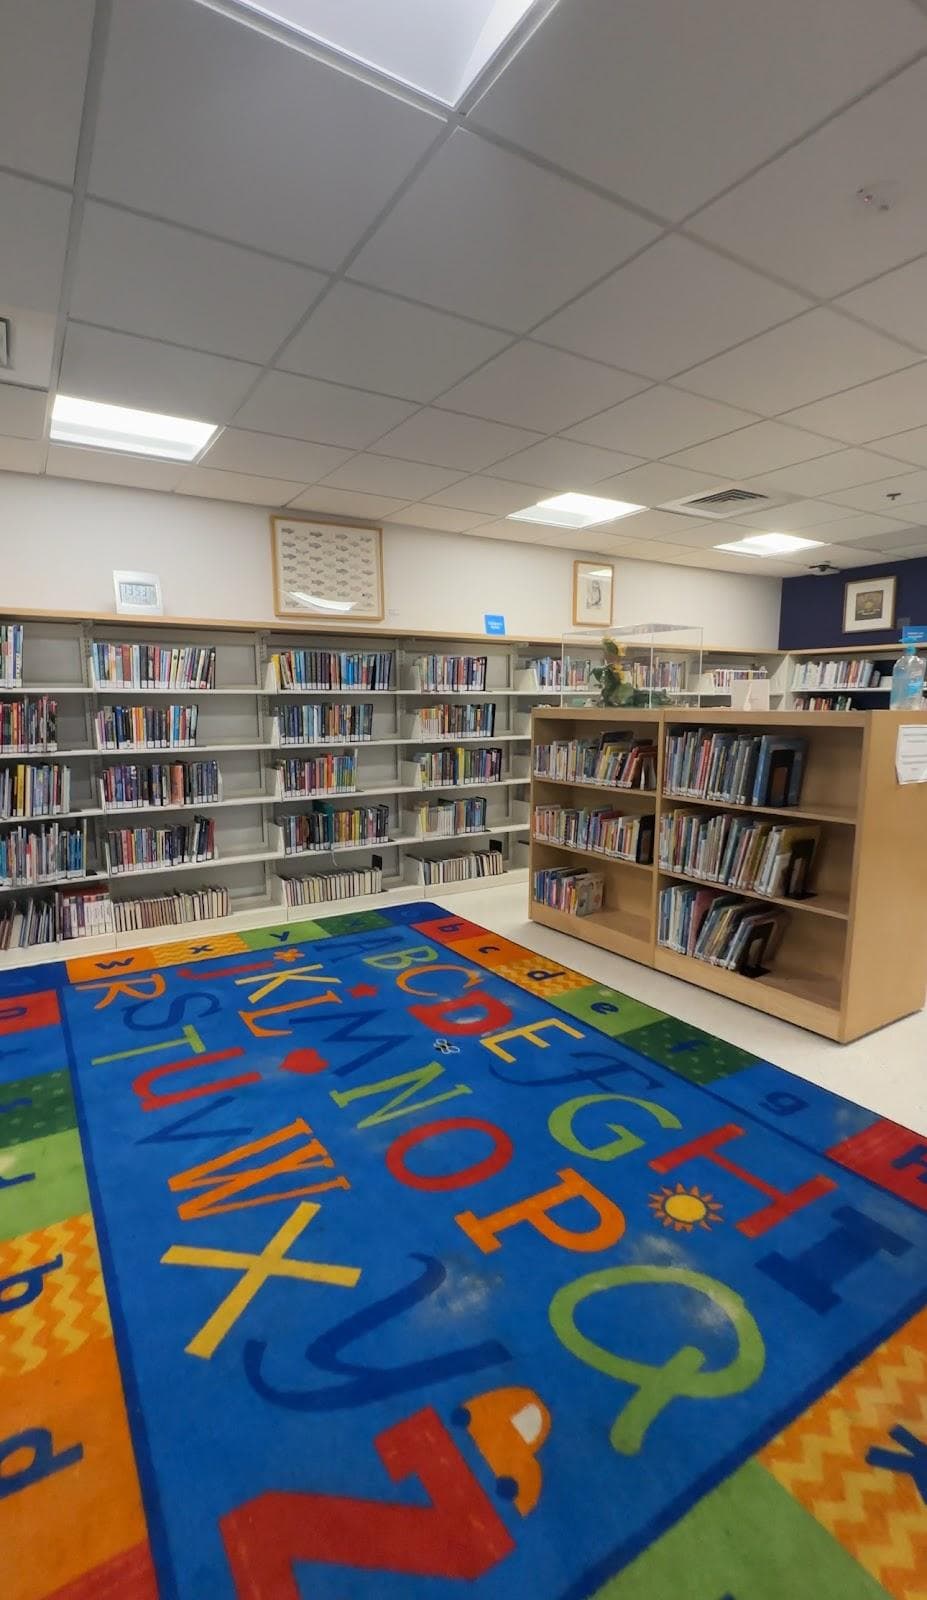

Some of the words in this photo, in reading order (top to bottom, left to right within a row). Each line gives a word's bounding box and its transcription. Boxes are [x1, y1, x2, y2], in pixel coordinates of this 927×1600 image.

[189, 944, 214, 955] x
[234, 963, 343, 1004] K
[362, 945, 439, 971] B
[395, 964, 485, 998] C
[438, 922, 465, 933] b
[478, 945, 501, 955] c
[590, 1001, 620, 1016] e
[74, 973, 166, 1010] R
[120, 991, 222, 1032] S
[238, 989, 343, 1038] L
[406, 989, 513, 1036] D
[91, 1024, 207, 1066] T
[288, 1009, 414, 1079] M
[480, 1017, 586, 1064] E
[131, 1046, 262, 1112] U
[329, 1061, 473, 1130] N
[133, 1095, 255, 1145] V
[385, 1116, 513, 1192] O
[547, 1093, 683, 1162] G
[167, 1116, 351, 1222] W
[648, 1122, 839, 1239] H
[454, 1167, 626, 1255] P
[160, 1200, 362, 1360] X
[754, 1205, 916, 1317] I
[243, 1253, 513, 1413] Y
[549, 1264, 766, 1457] Q
[218, 1405, 518, 1600] Z
